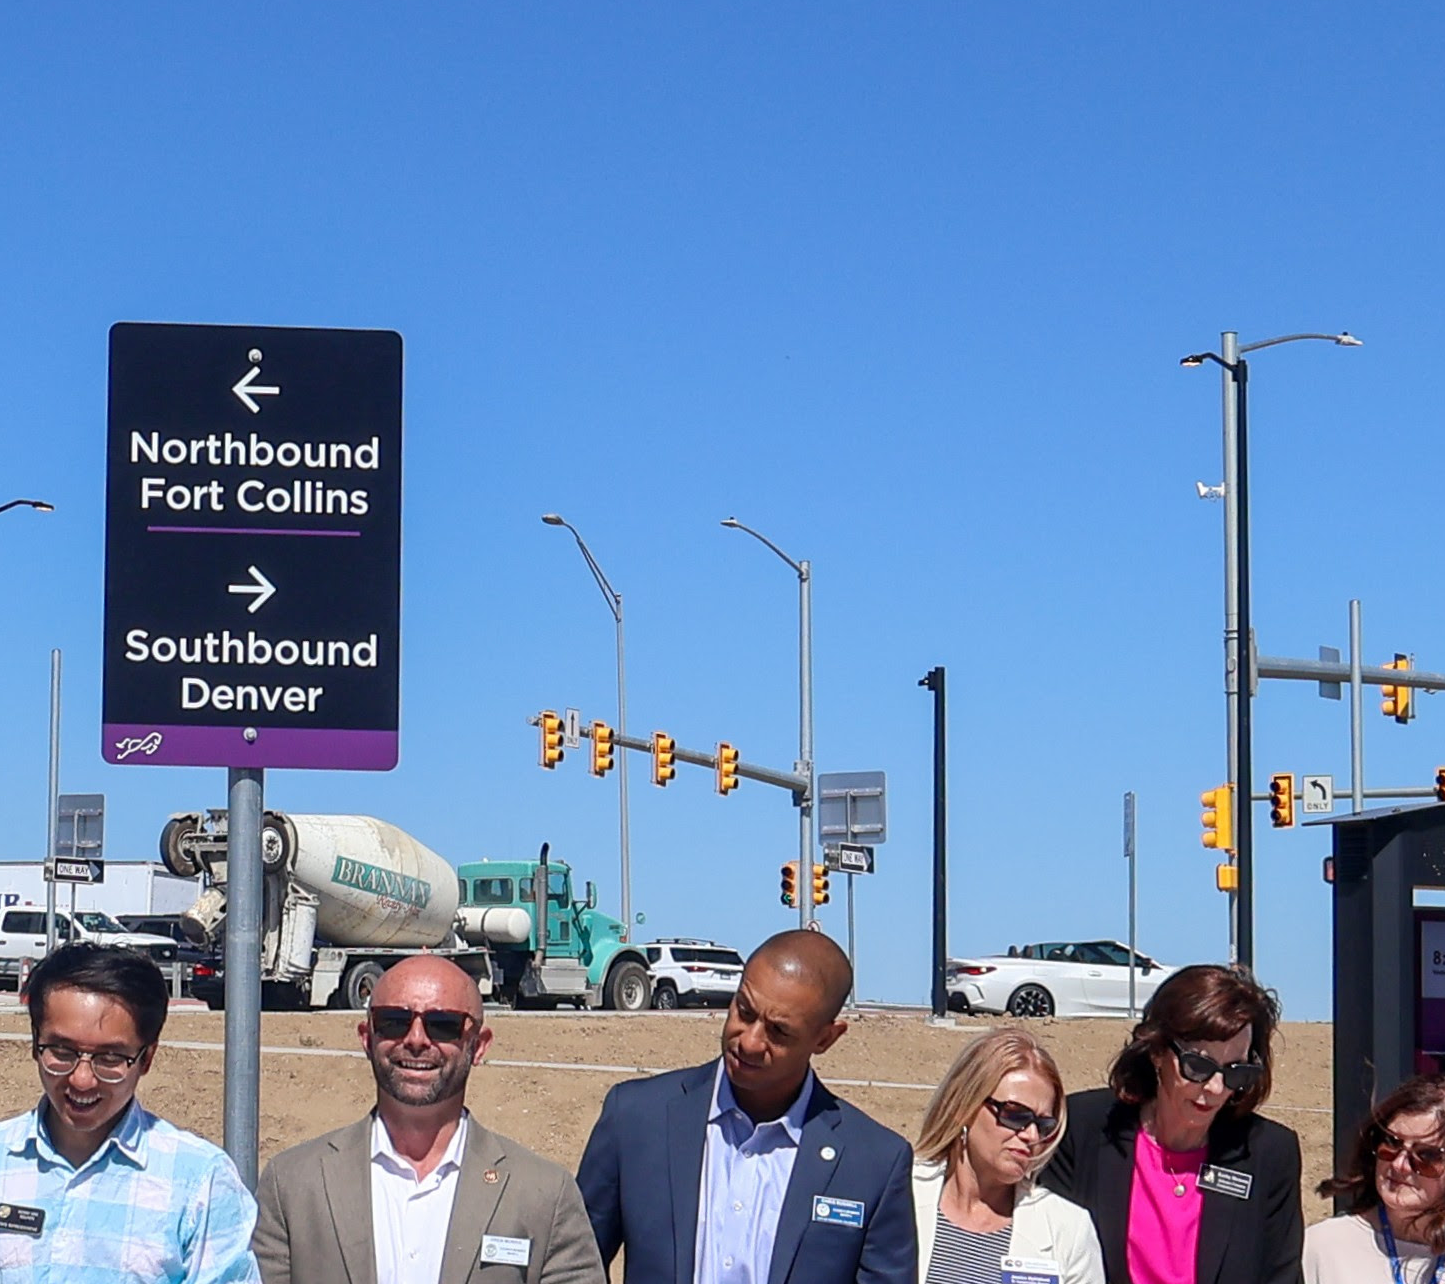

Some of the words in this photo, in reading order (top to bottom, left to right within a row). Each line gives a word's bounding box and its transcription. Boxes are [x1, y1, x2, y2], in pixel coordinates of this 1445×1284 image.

[130, 431, 380, 469] Northbound
[141, 477, 224, 511] Fort
[236, 480, 370, 515] Collins
[125, 629, 378, 667] Southbound
[181, 677, 323, 712] Denver
[1306, 801, 1329, 811] ONLY
[59, 864, 73, 875] ONE
[75, 864, 89, 876] WAY
